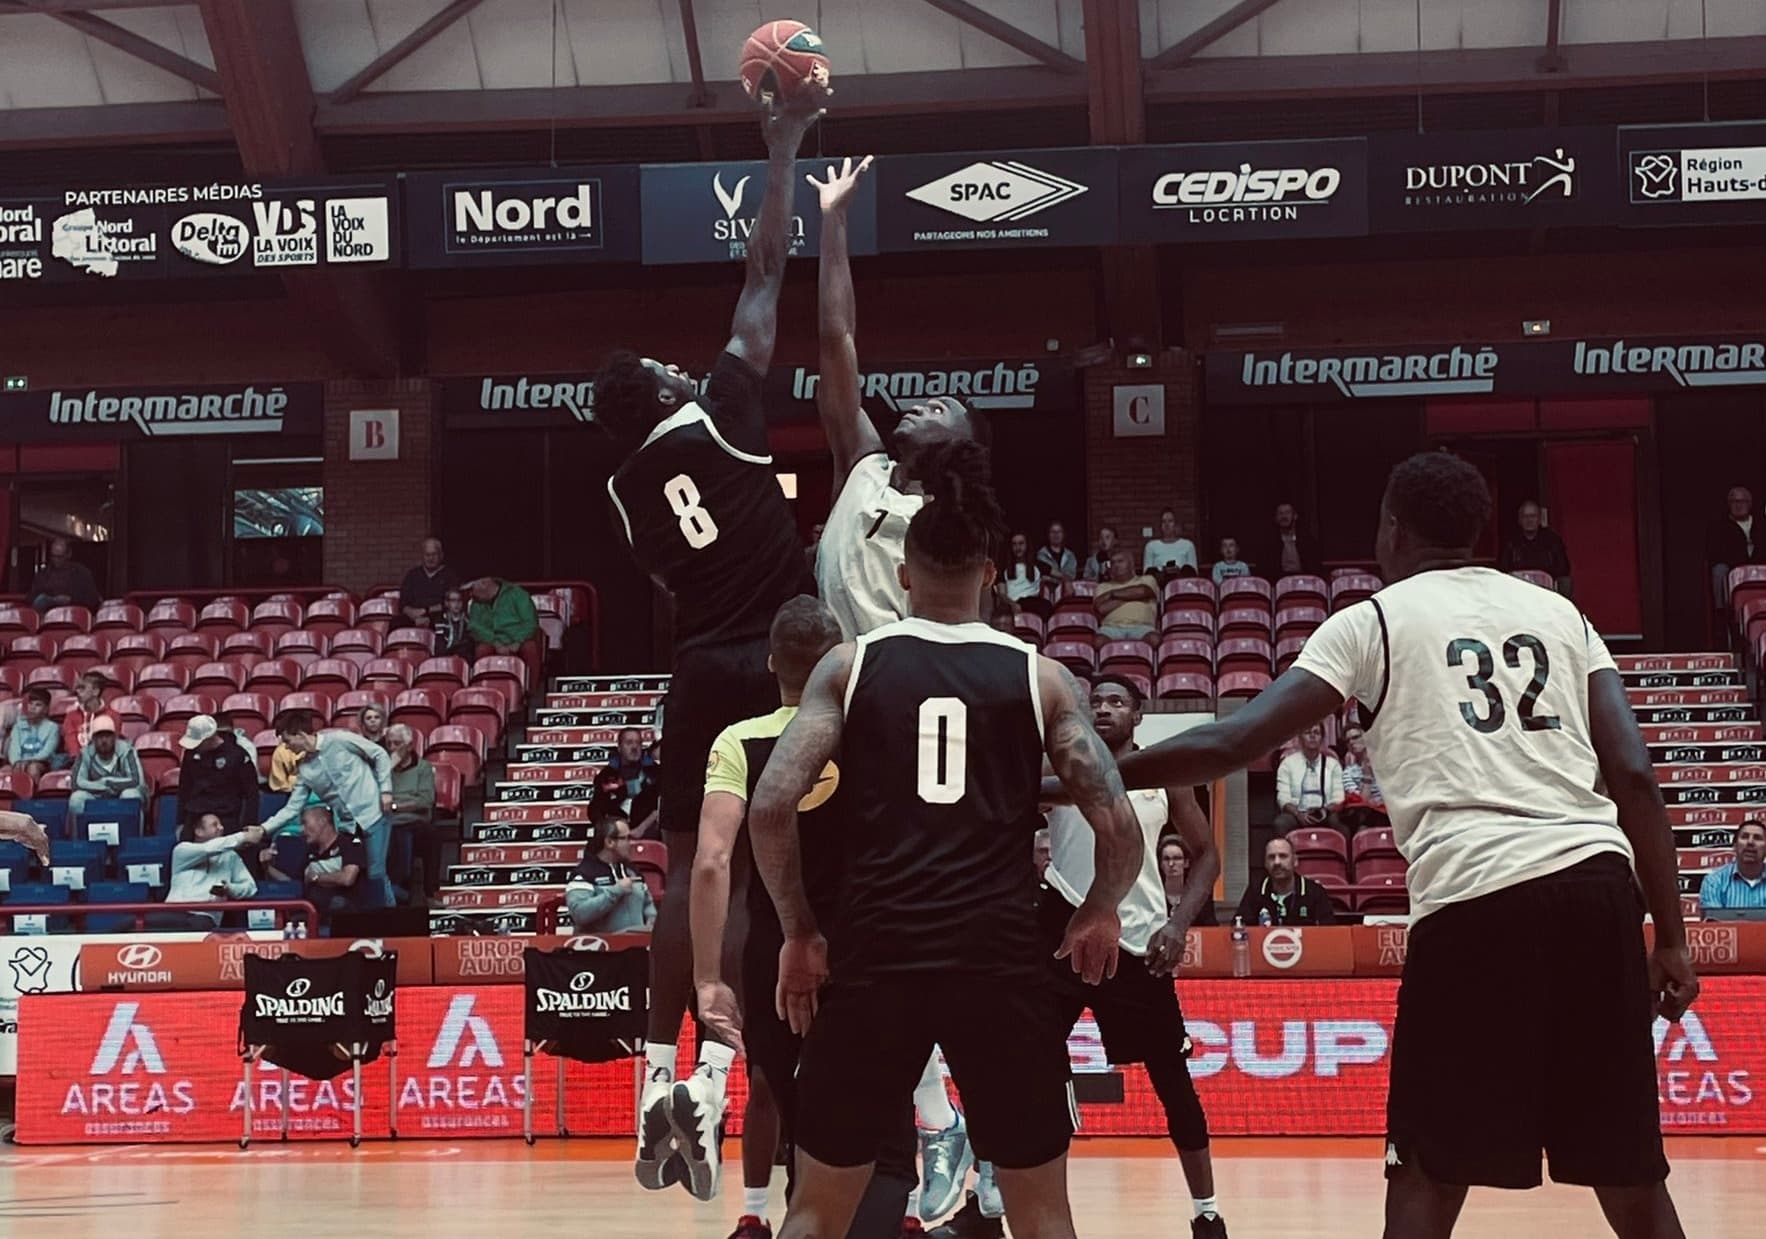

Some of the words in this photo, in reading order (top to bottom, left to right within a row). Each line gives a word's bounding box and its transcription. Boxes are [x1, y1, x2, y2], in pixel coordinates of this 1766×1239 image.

[1406, 163, 1533, 190] DUPONT
[1687, 156, 1743, 173] Région
[64, 187, 188, 206] PARTENAIRES
[193, 183, 263, 201] MÉDIAS
[950, 182, 1011, 201] SPAC
[0, 204, 33, 222] ord
[252, 200, 317, 236] VDS
[331, 205, 347, 217] LA
[455, 184, 592, 232] Nord
[1189, 206, 1297, 223] LOCATION
[97, 218, 133, 233] Nord
[180, 218, 240, 243] Delta
[332, 217, 365, 231] VOIX
[85, 233, 156, 252] Littoral
[256, 238, 274, 252] LA
[277, 237, 314, 252] VOIX
[332, 231, 354, 244] DU
[332, 243, 374, 257] NORD
[0, 256, 42, 279] are
[256, 254, 276, 263] DES
[277, 252, 315, 263] SPORTS
[1242, 345, 1498, 397] Intermarché
[49, 386, 288, 435] Intermarché
[1129, 395, 1152, 424] C
[364, 420, 385, 449] B
[664, 473, 719, 549] 8
[865, 509, 889, 539] 7
[1446, 633, 1562, 734] 32
[917, 697, 967, 804] 0
[458, 939, 525, 959] EUROP
[1686, 927, 1732, 948] ROP
[108, 969, 172, 984] HYUNDAI
[459, 957, 525, 976] AUTO
[255, 991, 345, 1017] SPALDING
[536, 986, 631, 1012] SPALDING
[1184, 1020, 1388, 1078] CUP
[61, 1081, 196, 1115] AREAS
[230, 1078, 365, 1112] AREAS
[398, 1074, 534, 1109] AREAS
[1658, 1070, 1753, 1106] EAS
